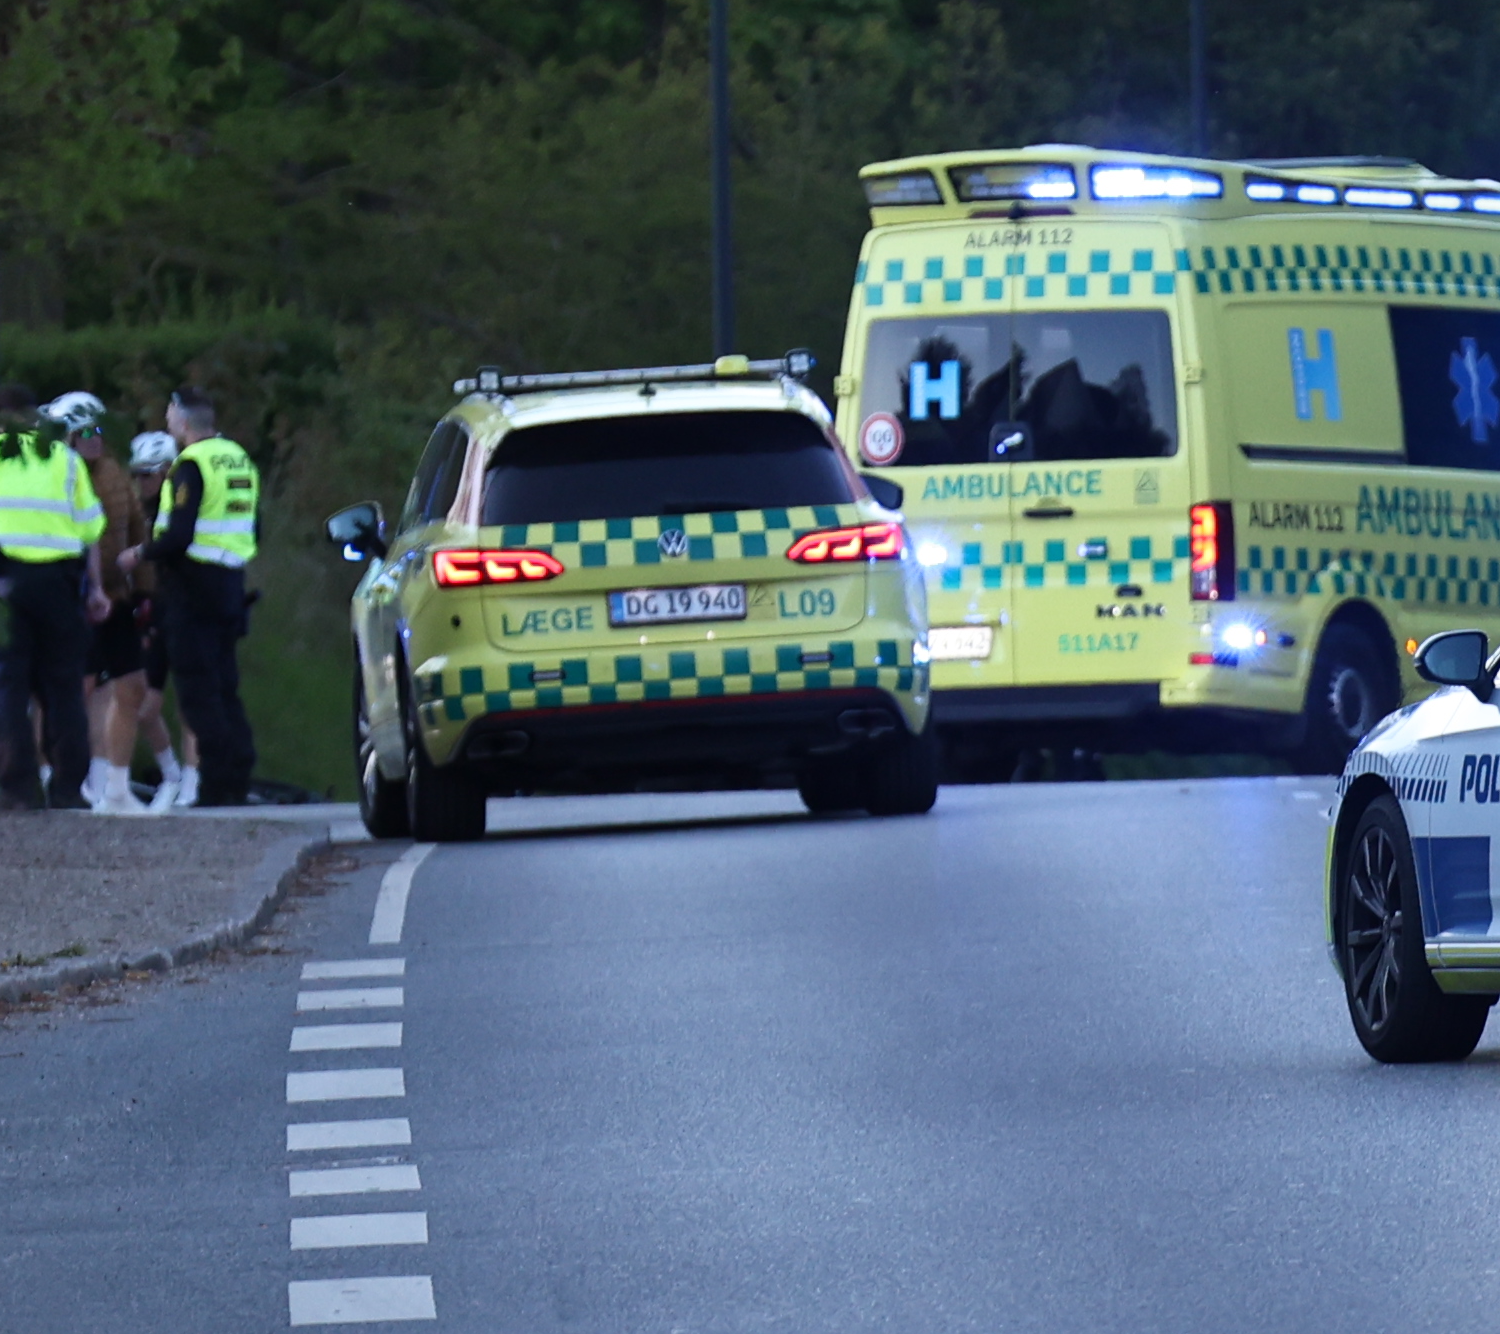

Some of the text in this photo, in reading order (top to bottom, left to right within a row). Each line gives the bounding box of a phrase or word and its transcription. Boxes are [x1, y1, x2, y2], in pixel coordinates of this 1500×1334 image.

[964, 228, 1073, 247] ALARM 112
[1287, 327, 1343, 422] H
[910, 360, 961, 421] H
[922, 470, 1103, 501] AMBULANCE
[1249, 501, 1344, 533] ALARM 112
[626, 588, 740, 617] DG 19 940
[779, 589, 836, 617] L09
[1097, 603, 1167, 618] MAN
[502, 606, 593, 636] LÆGE
